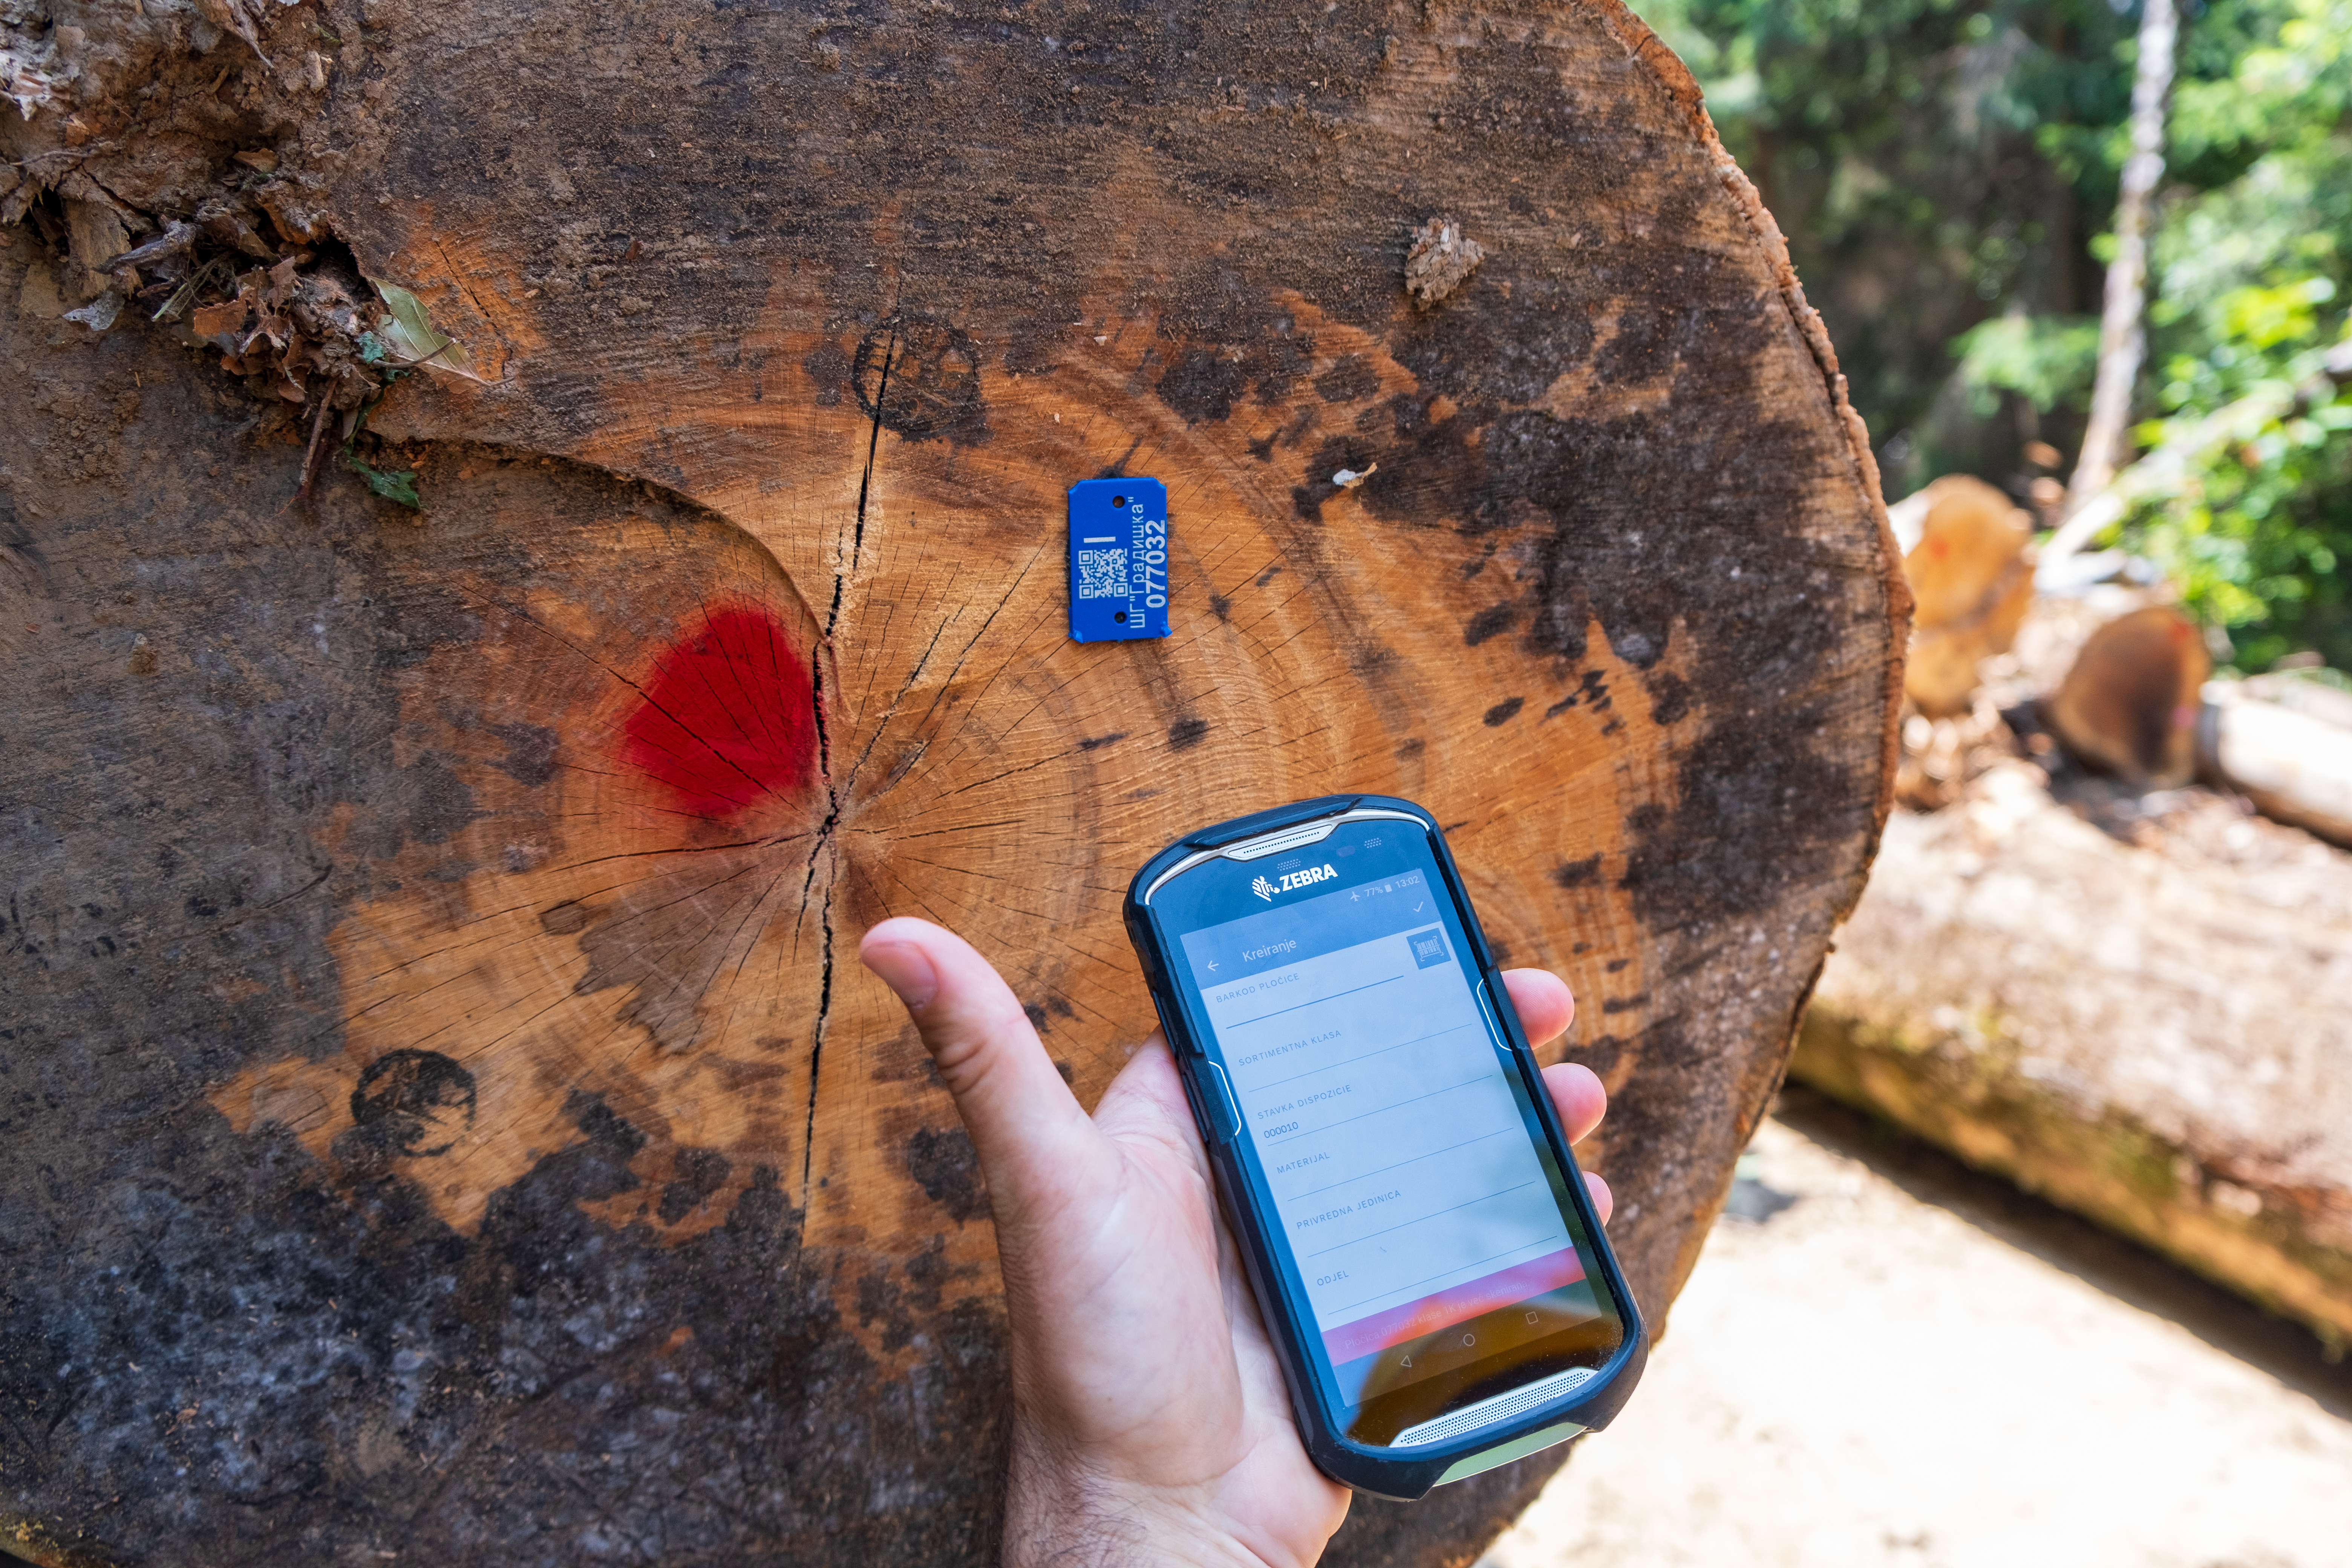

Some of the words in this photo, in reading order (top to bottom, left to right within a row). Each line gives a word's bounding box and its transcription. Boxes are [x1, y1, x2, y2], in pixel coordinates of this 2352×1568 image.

[1145, 520, 1166, 608] 077032
[1279, 864, 1338, 892] ZEBRA
[1364, 886, 1383, 897] 77%
[1395, 875, 1420, 888] 13:02
[1242, 939, 1297, 962] Kreiranje
[1216, 985, 1256, 1003] BARKOD
[1259, 972, 1300, 991] PLOČICE
[1238, 1040, 1308, 1066] SORTIMENTNA
[1311, 1030, 1341, 1044] KLASA
[1257, 1102, 1294, 1119] STAVKA
[1297, 1084, 1352, 1107] DISPOZICIE
[1263, 1121, 1299, 1138] 000010
[1277, 1152, 1330, 1174] MATERIJAL
[1296, 1205, 1353, 1230] PRIVREDNA
[1357, 1190, 1401, 1210] JEDINICA
[1317, 1270, 1349, 1286] ODJEL
[1344, 1332, 1380, 1349] Pločica
[1381, 1317, 1416, 1337] 077032
[1417, 1310, 1442, 1324] klase
[1457, 1301, 1466, 1312] je
